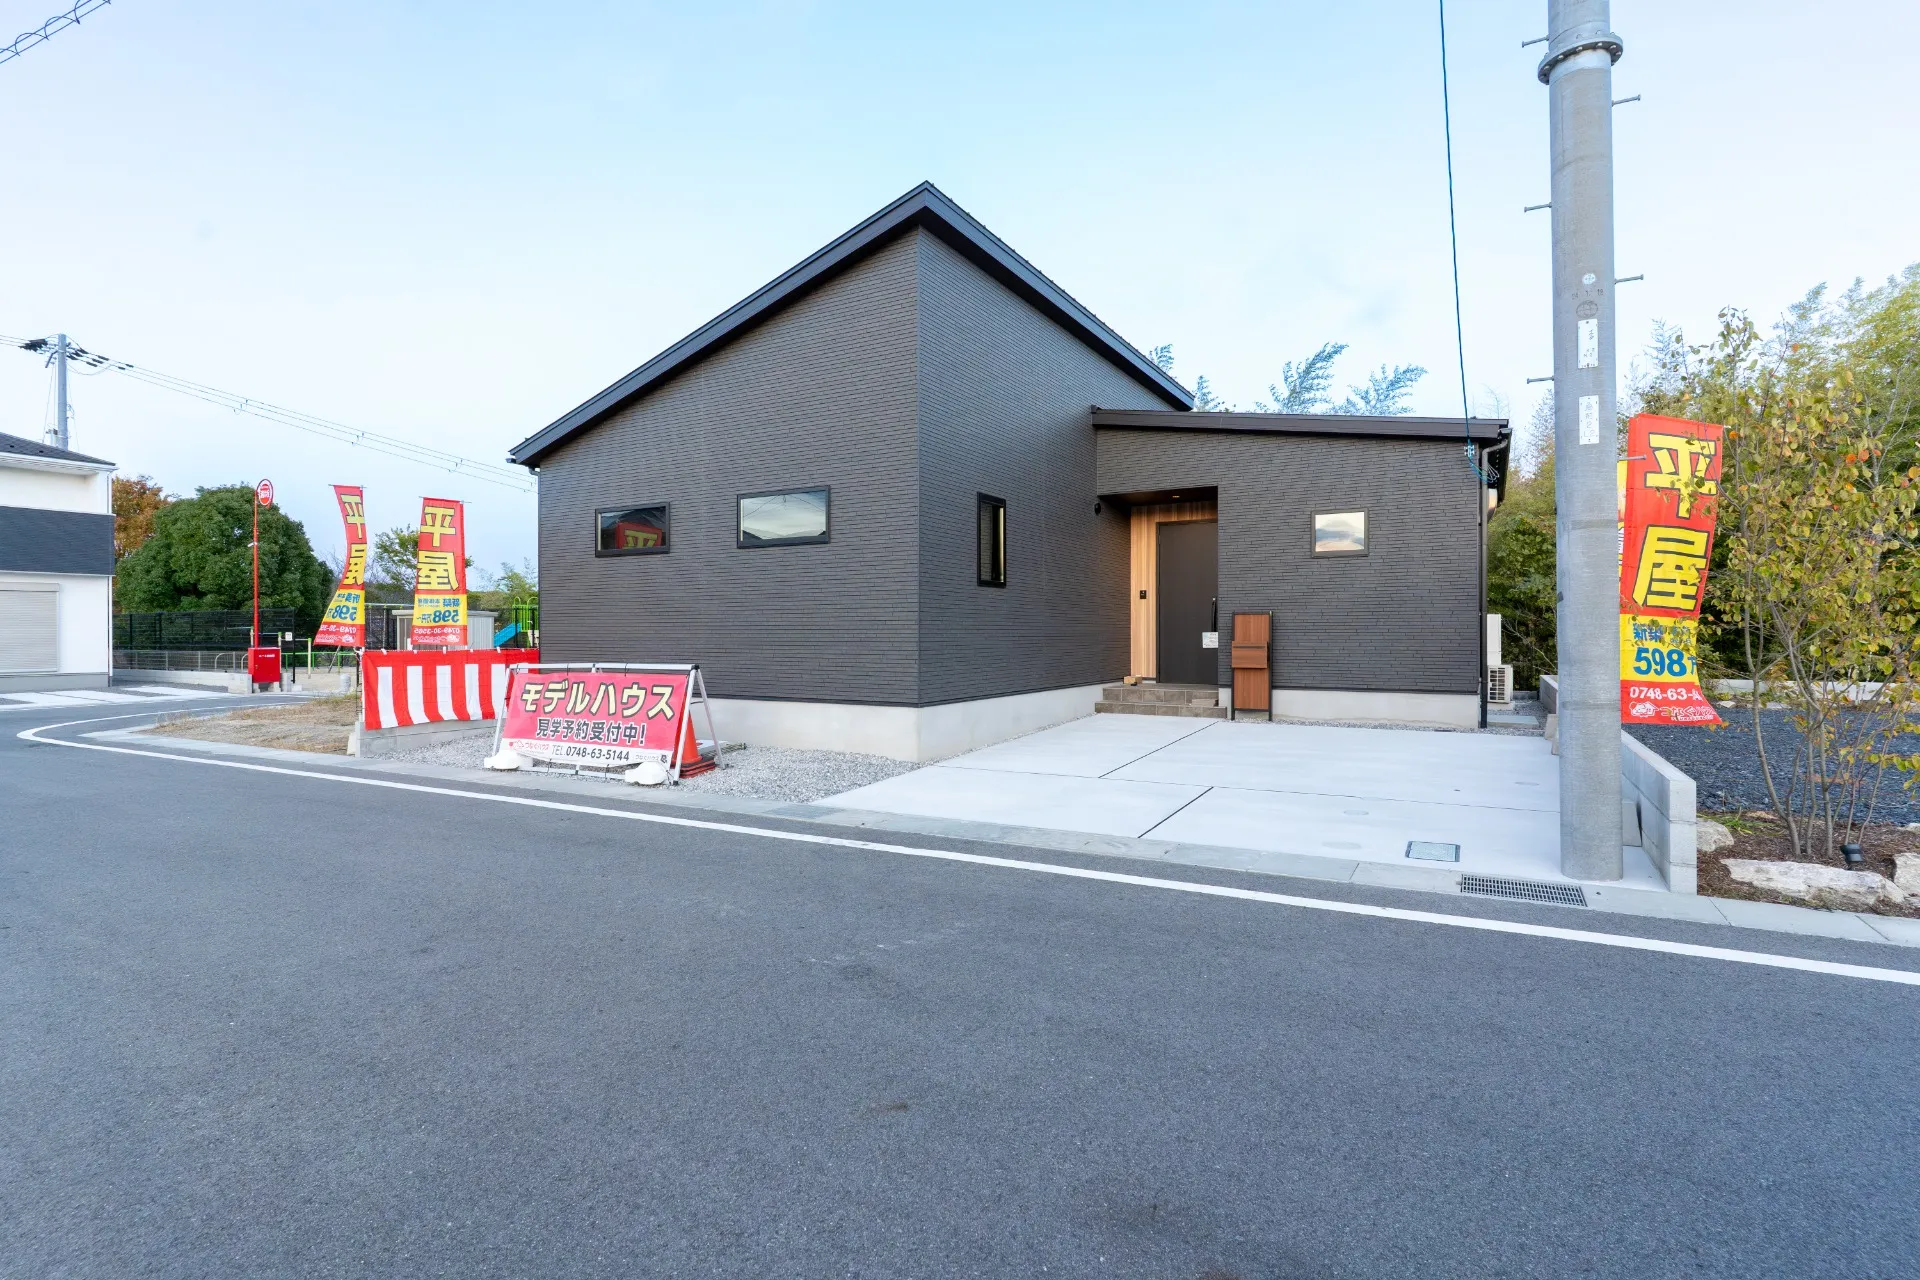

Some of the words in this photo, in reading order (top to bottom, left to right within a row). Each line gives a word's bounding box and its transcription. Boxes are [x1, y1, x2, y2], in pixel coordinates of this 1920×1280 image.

[1632, 431, 1717, 611] 平屋
[521, 678, 676, 721] モデルハウス
